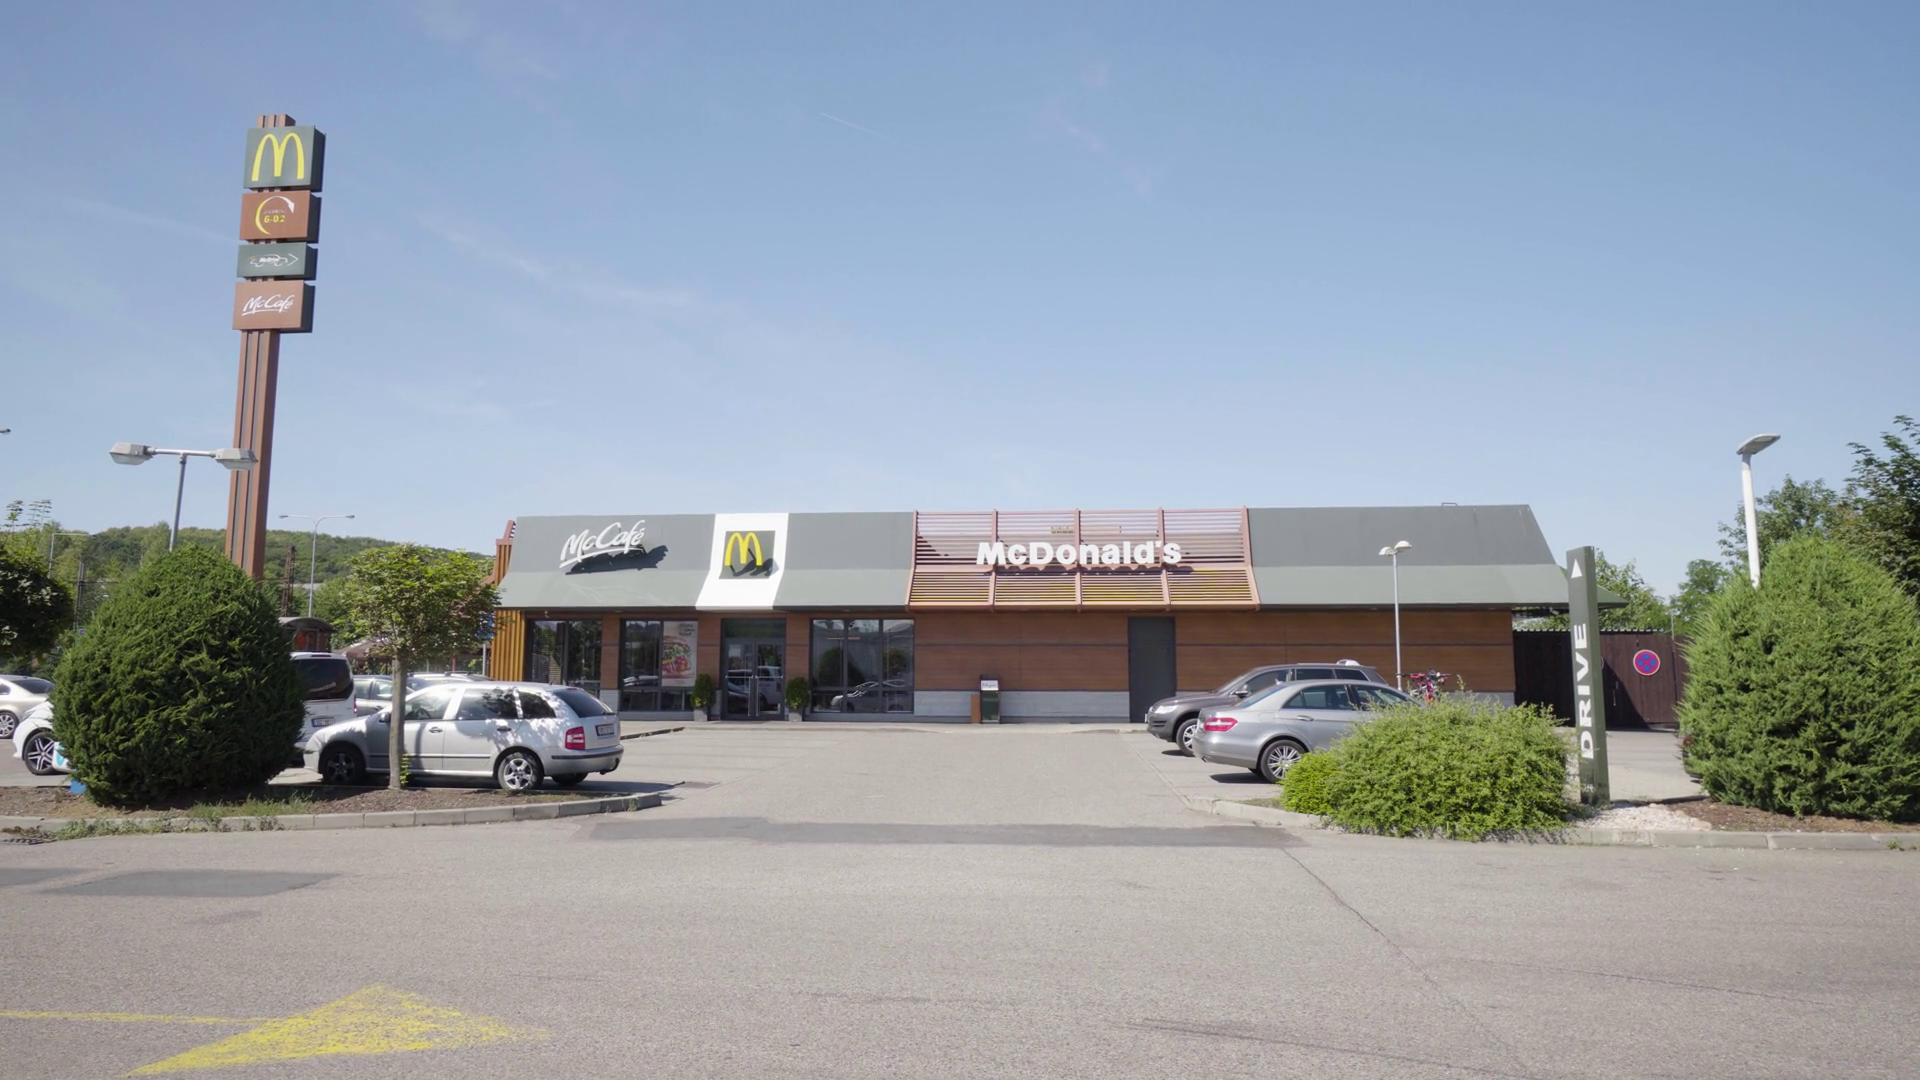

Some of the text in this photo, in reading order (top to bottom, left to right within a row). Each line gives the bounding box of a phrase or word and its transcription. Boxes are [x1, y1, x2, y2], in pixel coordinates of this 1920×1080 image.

[242, 294, 295, 315] McCafé
[560, 520, 645, 565] McCafé
[976, 541, 1182, 565] McDonald's
[1574, 623, 1594, 759] DRIVE
